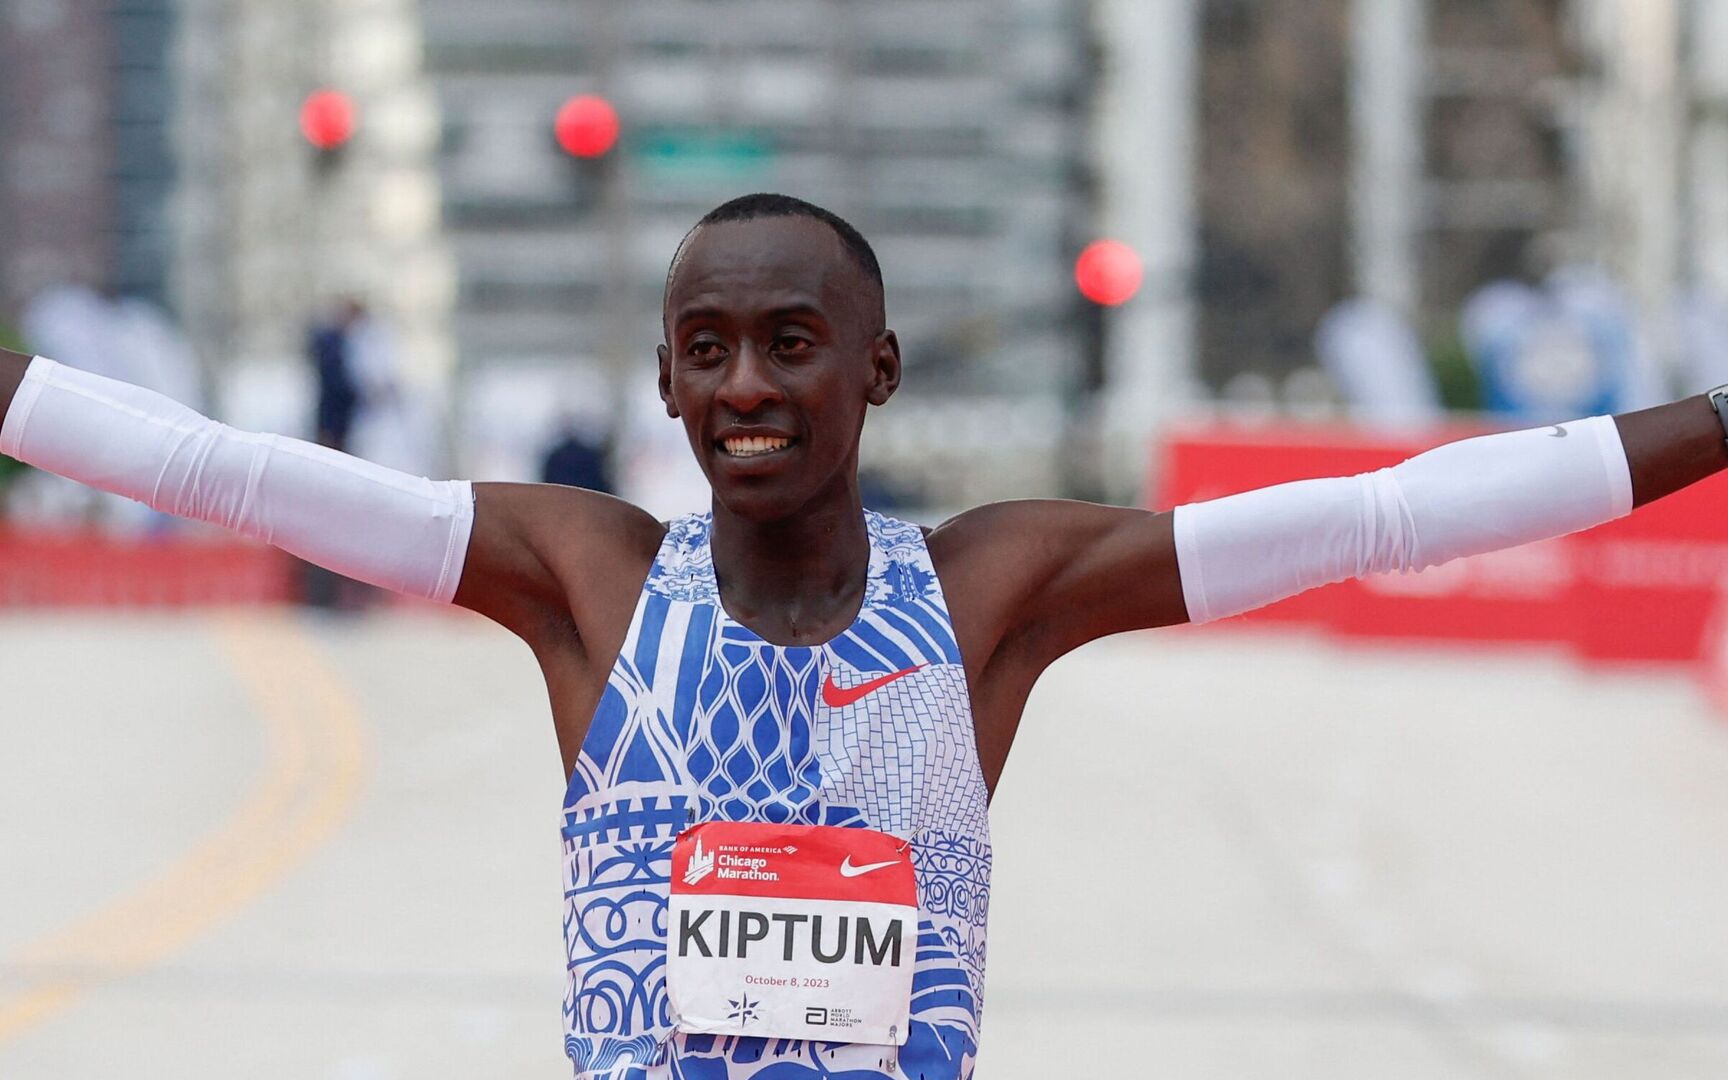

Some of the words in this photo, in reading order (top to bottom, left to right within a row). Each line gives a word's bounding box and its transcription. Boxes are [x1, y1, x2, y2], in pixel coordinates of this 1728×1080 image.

[718, 855, 767, 869] Chicago
[678, 909, 903, 968] KIPTUM
[745, 974, 787, 986] October
[790, 977, 800, 988] 8,
[803, 978, 830, 988] 2023
